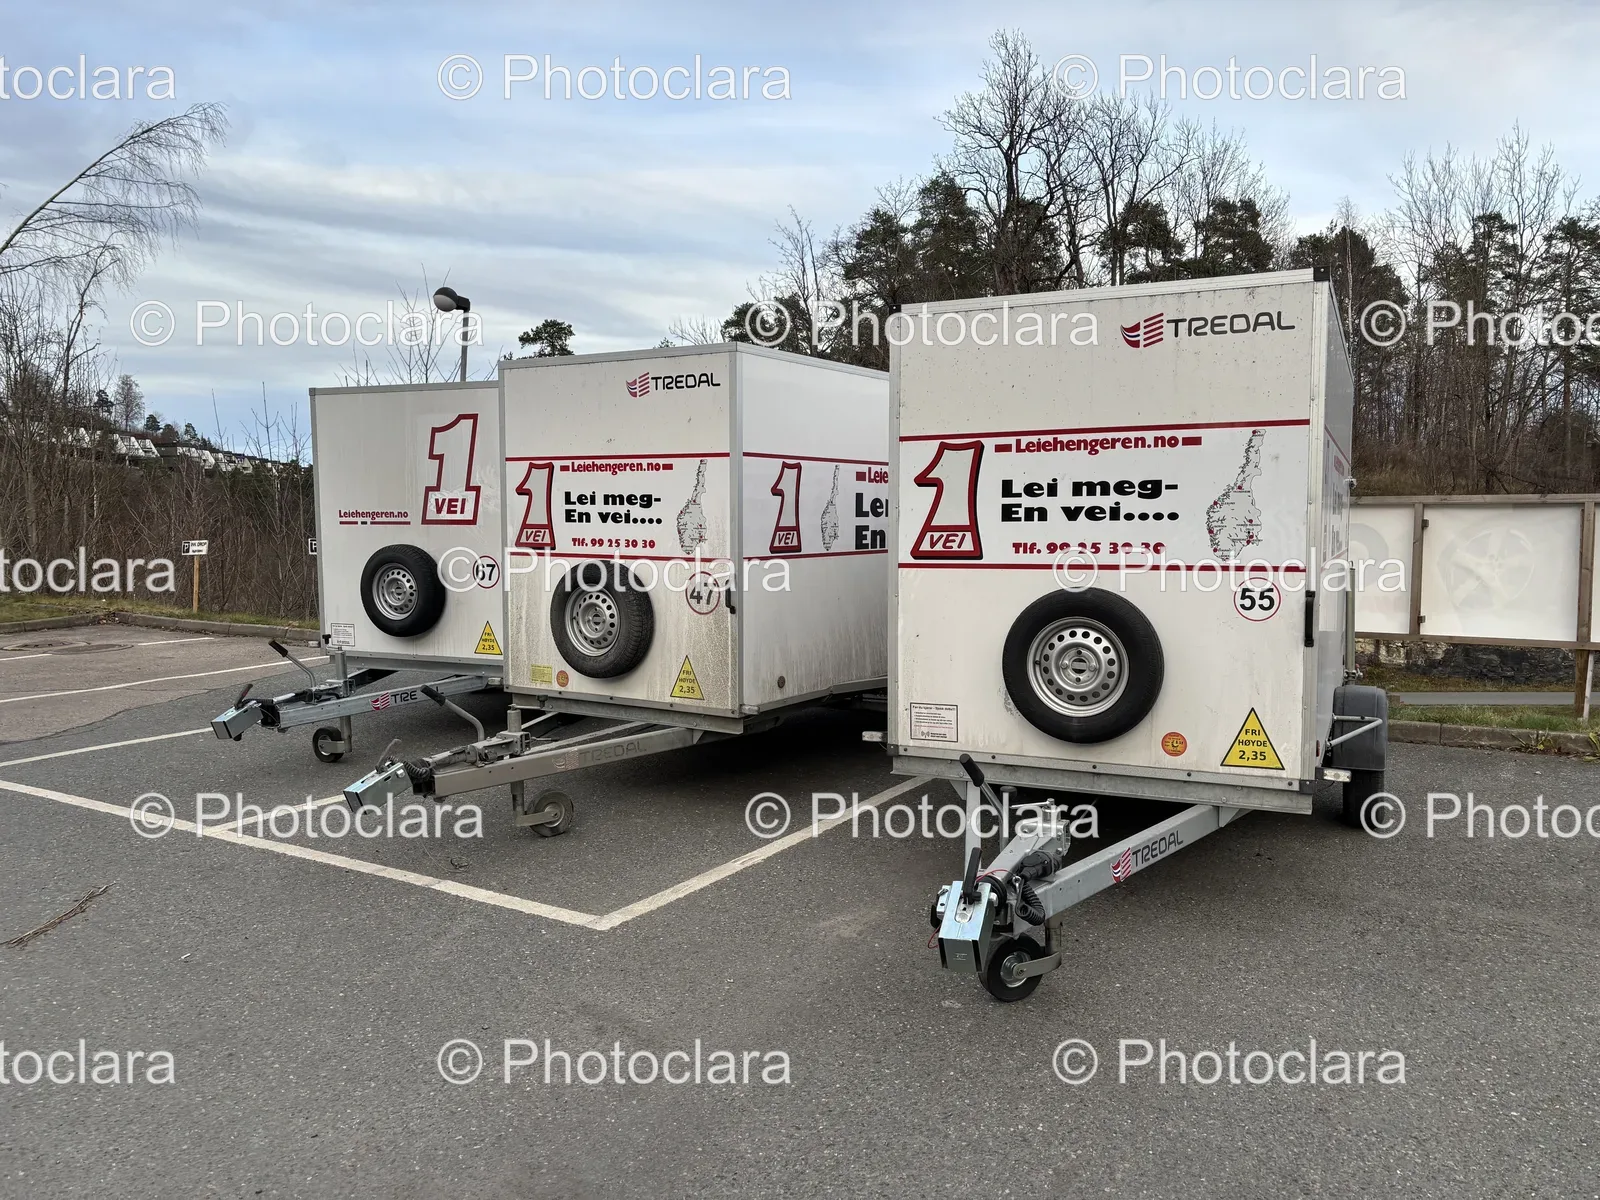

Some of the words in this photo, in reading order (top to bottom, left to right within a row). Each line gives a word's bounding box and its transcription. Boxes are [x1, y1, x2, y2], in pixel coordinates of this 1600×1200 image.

[1167, 311, 1296, 337] TREDAL
[651, 372, 721, 391] TREDAL
[1015, 435, 1180, 455] Leiehengeren.no
[571, 461, 662, 475] Leiehengeren.no
[1001, 477, 1058, 498] Lei
[1072, 478, 1179, 499] meg-
[434, 498, 467, 515] VEI
[564, 491, 596, 506] Lei
[603, 493, 662, 508] meg-
[338, 509, 409, 521] Leiehengeren.no
[564, 509, 591, 523] En
[598, 510, 663, 524] vei....
[1001, 502, 1048, 522] En
[1061, 501, 1180, 522] vei....
[524, 530, 547, 543] VEI
[590, 537, 604, 547] 99
[607, 538, 621, 548] 25
[624, 538, 638, 549] 30
[642, 539, 656, 549] 30
[777, 532, 795, 545] VEI
[928, 533, 967, 550] VEI
[690, 581, 717, 605] 47
[1239, 588, 1276, 612] 55
[679, 685, 696, 694] 2,35
[1237, 739, 1268, 748] HØYDE
[580, 741, 647, 765] TREDAL
[1238, 750, 1267, 761] 2,35
[1132, 830, 1184, 867] TREDAL
